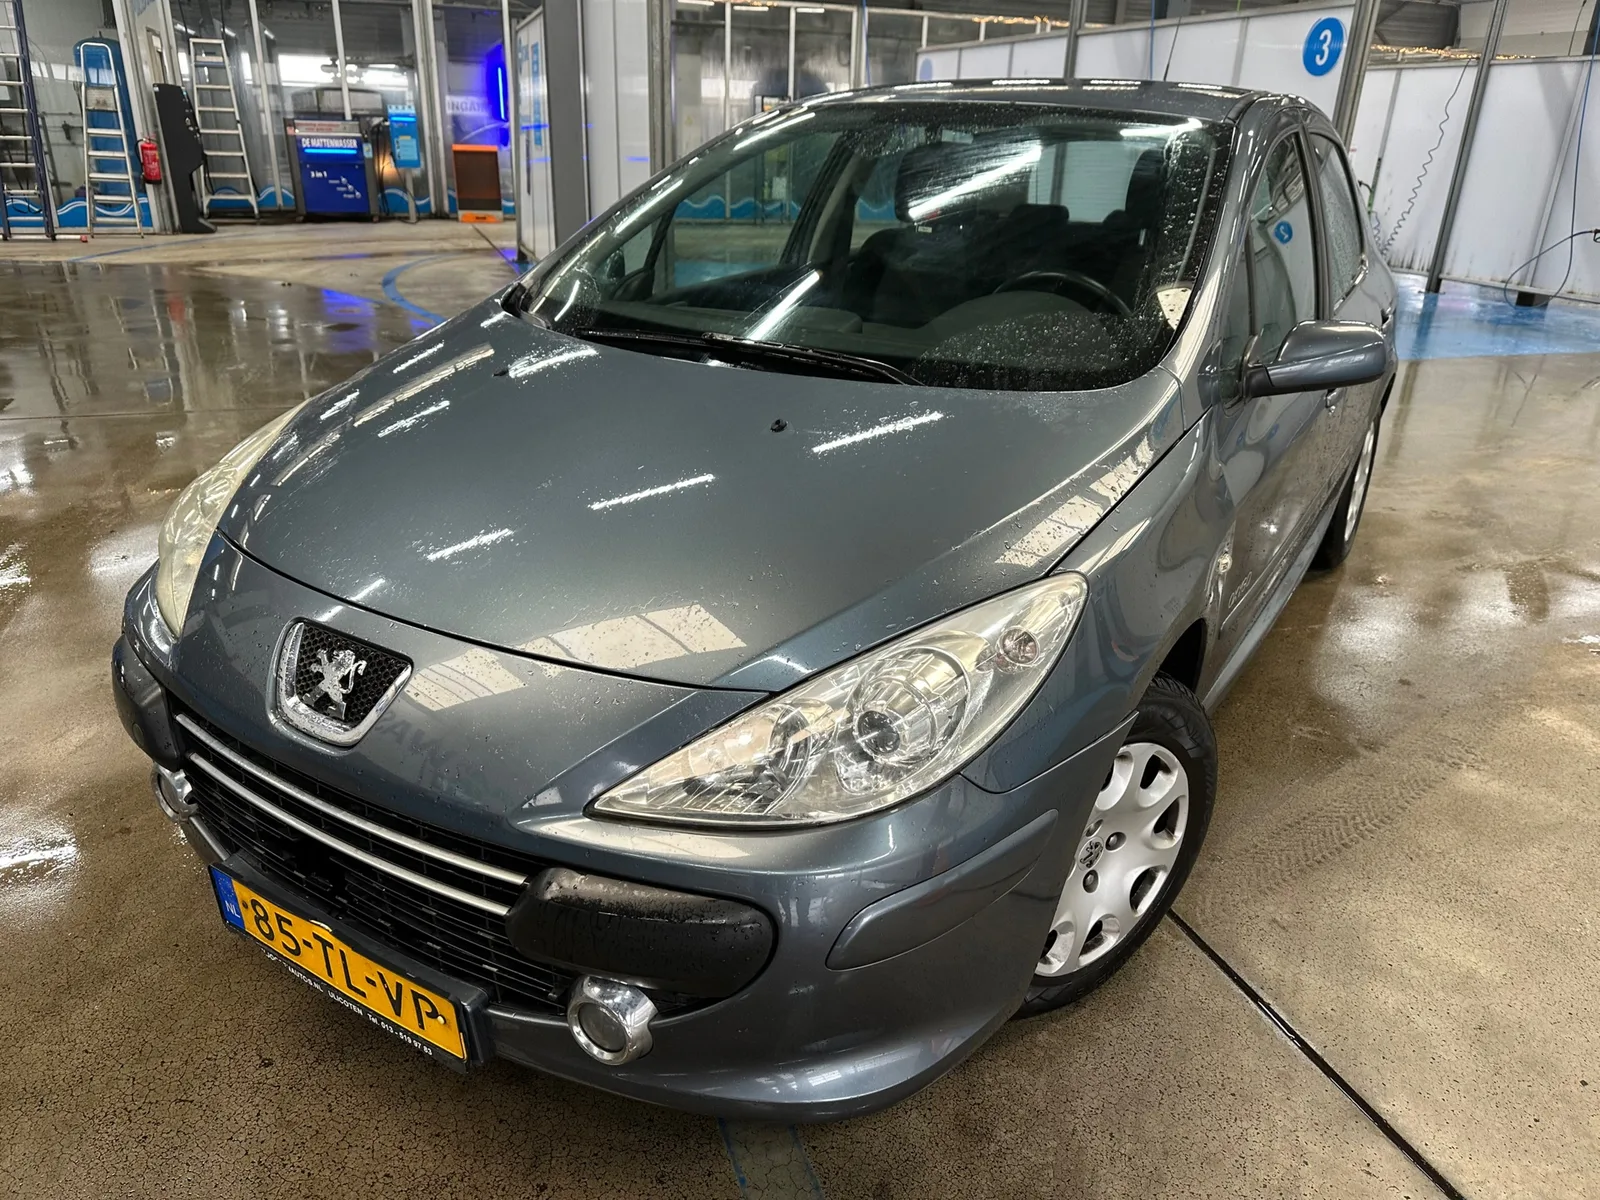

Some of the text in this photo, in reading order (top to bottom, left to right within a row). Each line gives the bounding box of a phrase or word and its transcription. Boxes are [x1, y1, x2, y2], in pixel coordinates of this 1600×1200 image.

[1315, 29, 1332, 66] 3
[447, 100, 486, 112] INGAN
[301, 138, 311, 148] DE
[225, 900, 241, 918] NL
[250, 898, 440, 1031] 85-TL-VP
[367, 1013, 380, 1026] Tel.
